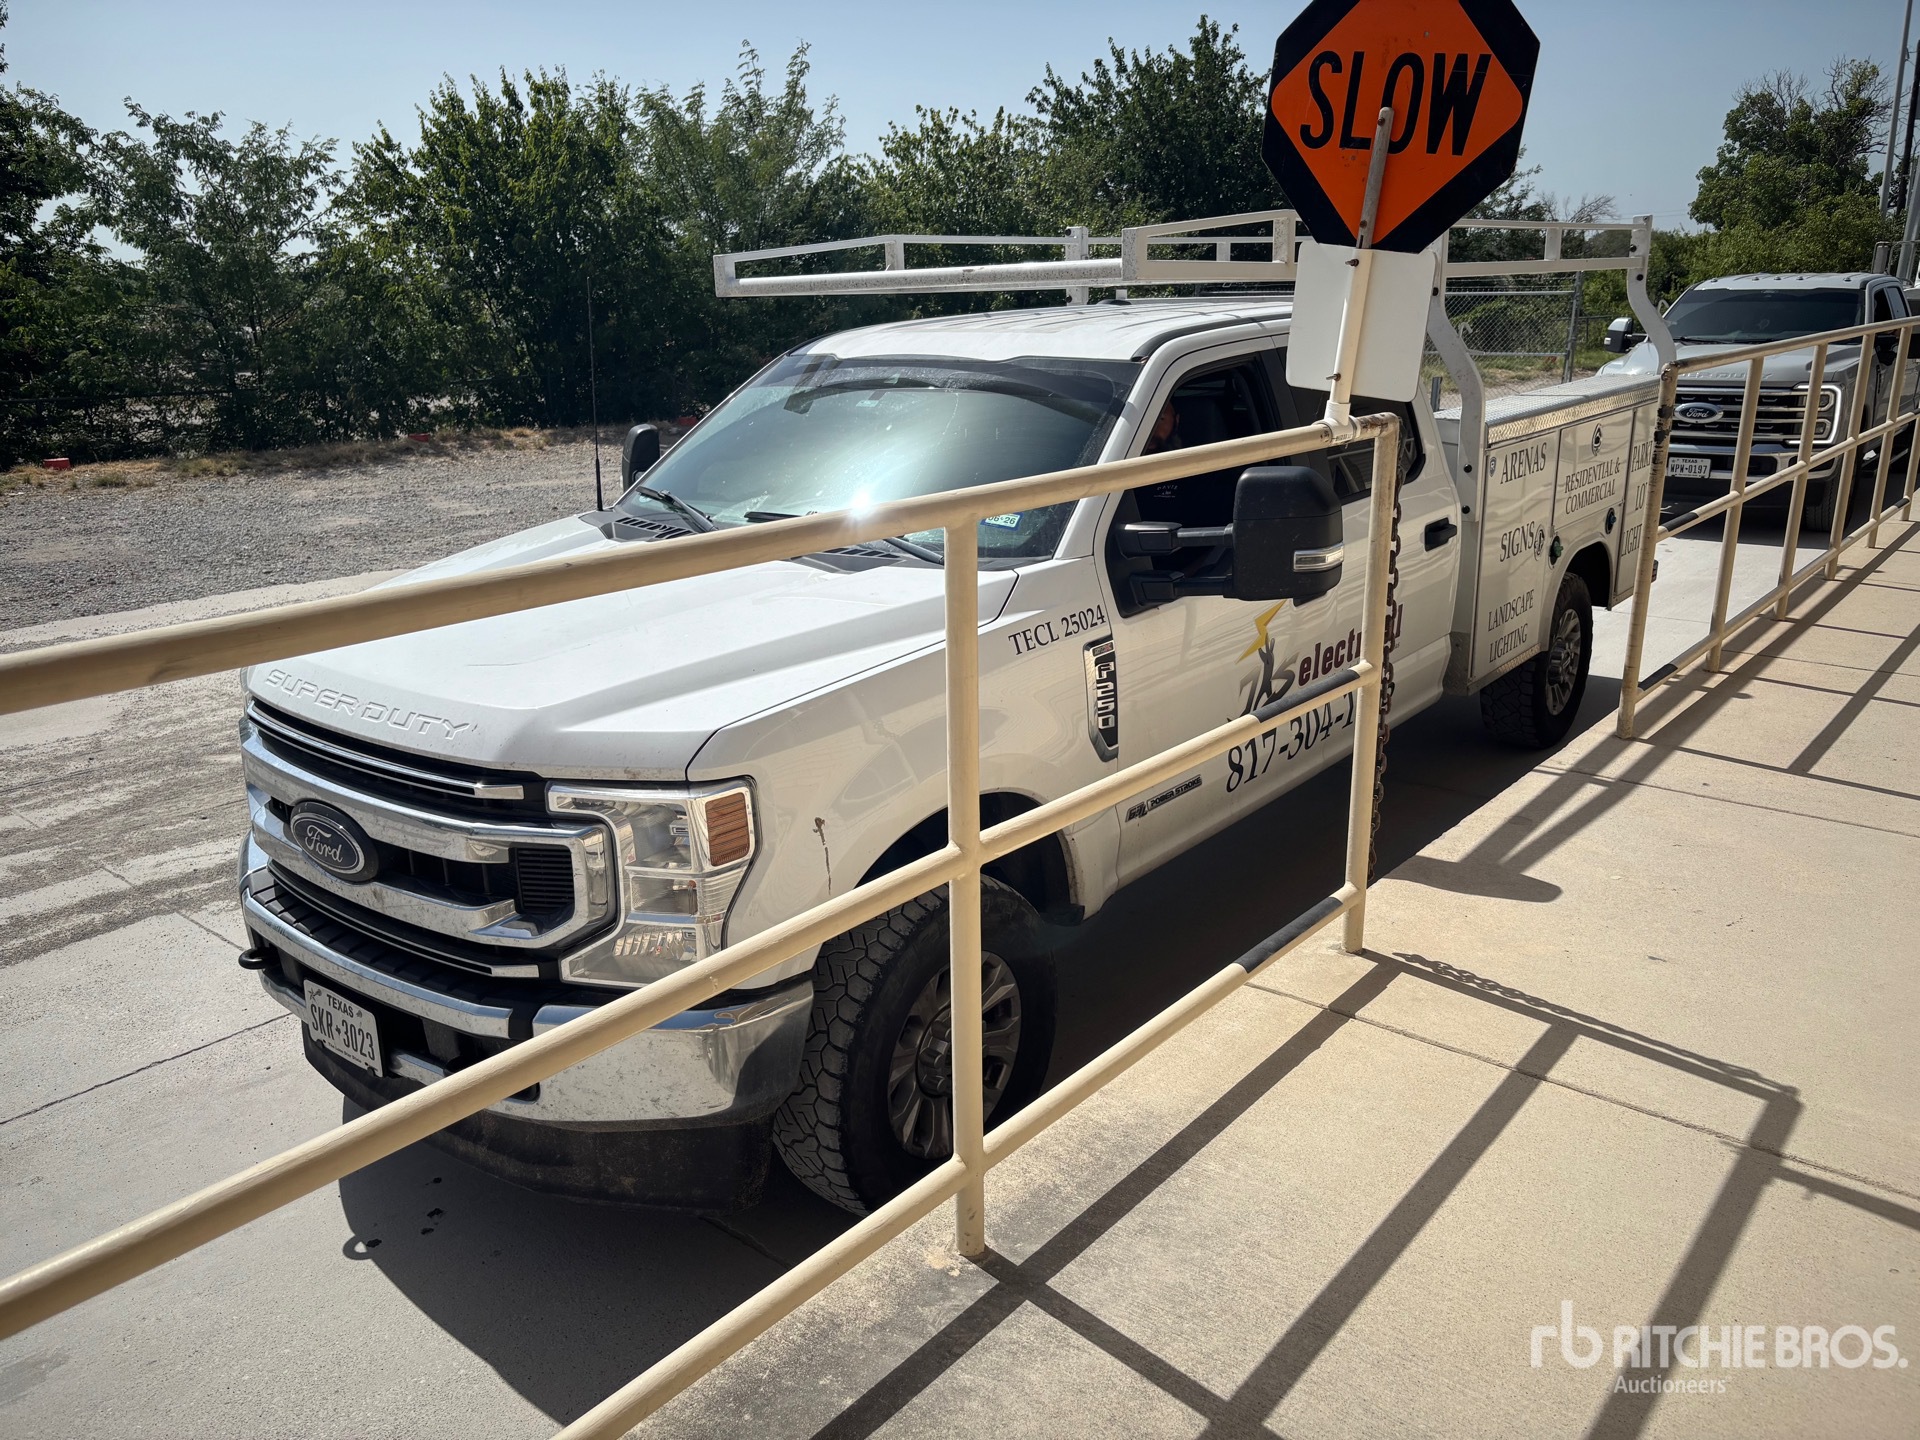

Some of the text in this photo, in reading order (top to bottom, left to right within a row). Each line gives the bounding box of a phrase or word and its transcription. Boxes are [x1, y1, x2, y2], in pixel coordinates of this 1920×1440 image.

[1299, 50, 1492, 156] SLOW
[1685, 408, 1710, 419] Ford
[1500, 441, 1548, 485] ARENAS
[1564, 456, 1621, 494] RESIDENTIAL &
[1565, 478, 1616, 515] COMMERCIAL
[1635, 481, 1648, 511] LO
[1500, 520, 1536, 562] SIGNS
[1008, 604, 1106, 656] TECL 25024
[1488, 589, 1535, 632] LANDSCAPE
[1489, 622, 1528, 663] LIGHTING
[264, 668, 471, 740] SUPER DUTY
[1150, 790, 1175, 807] POWER
[1174, 776, 1202, 795] STROKE
[303, 823, 344, 864] Ford
[326, 993, 354, 1019] TEXAS
